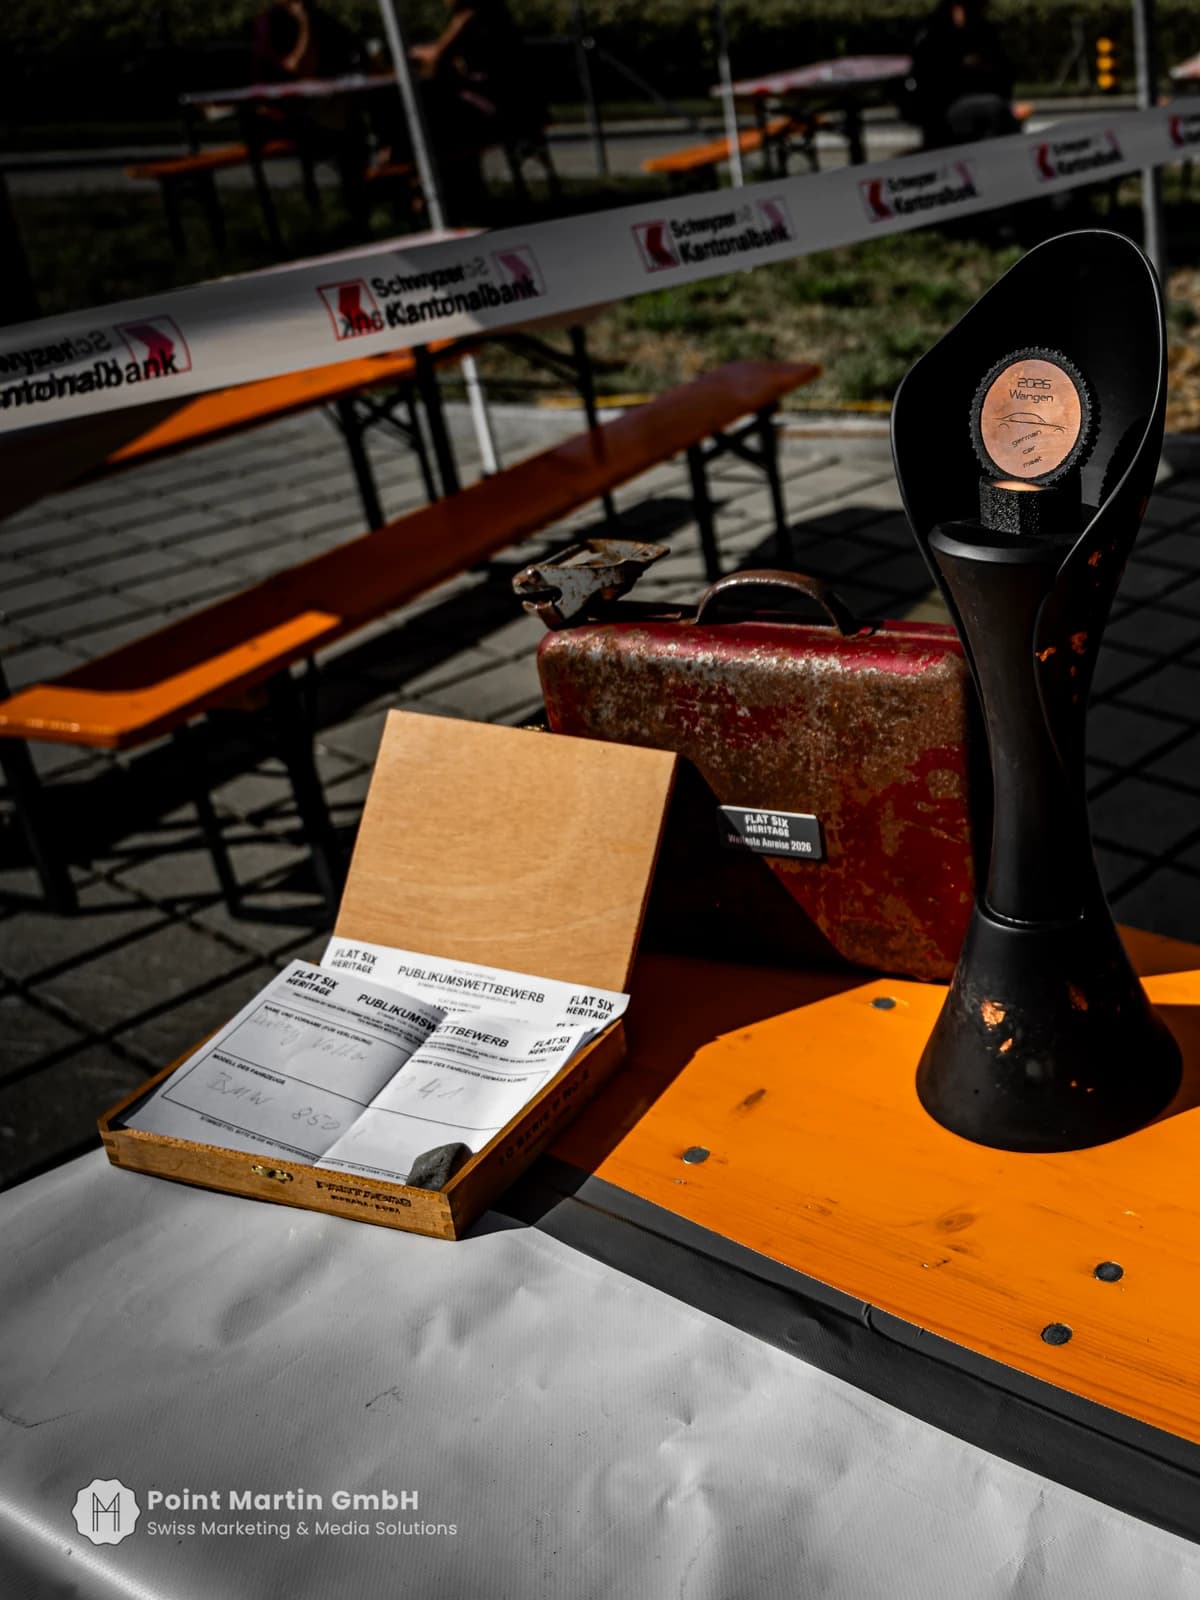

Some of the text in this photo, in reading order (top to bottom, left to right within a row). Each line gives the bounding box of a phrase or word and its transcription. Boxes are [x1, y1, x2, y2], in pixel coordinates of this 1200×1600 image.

[670, 212, 737, 239] Schwyzer
[679, 222, 793, 265] Kantonalbank
[371, 264, 467, 299] Schwyzer
[386, 274, 540, 329] Kantonalbank
[1009, 389, 1054, 404] Wangen
[1012, 430, 1043, 447] german
[1022, 445, 1037, 455] car
[1023, 456, 1043, 468] meet
[745, 814, 789, 828] FLAT SIX
[746, 825, 790, 838] HERITAGE
[762, 838, 790, 850] Anreise
[791, 840, 812, 853] 2026
[335, 949, 378, 966] FLAT SIX
[331, 959, 374, 974] HERITAGE
[286, 977, 332, 997] HERITAGE
[292, 969, 339, 990] FLAT SIX
[397, 965, 546, 1004] PUBLIKUMSWETTBEWERB
[570, 994, 615, 1013] FLAT SIX
[528, 1044, 567, 1056] HERITAGE
[534, 1035, 573, 1048] FLAT SIX
